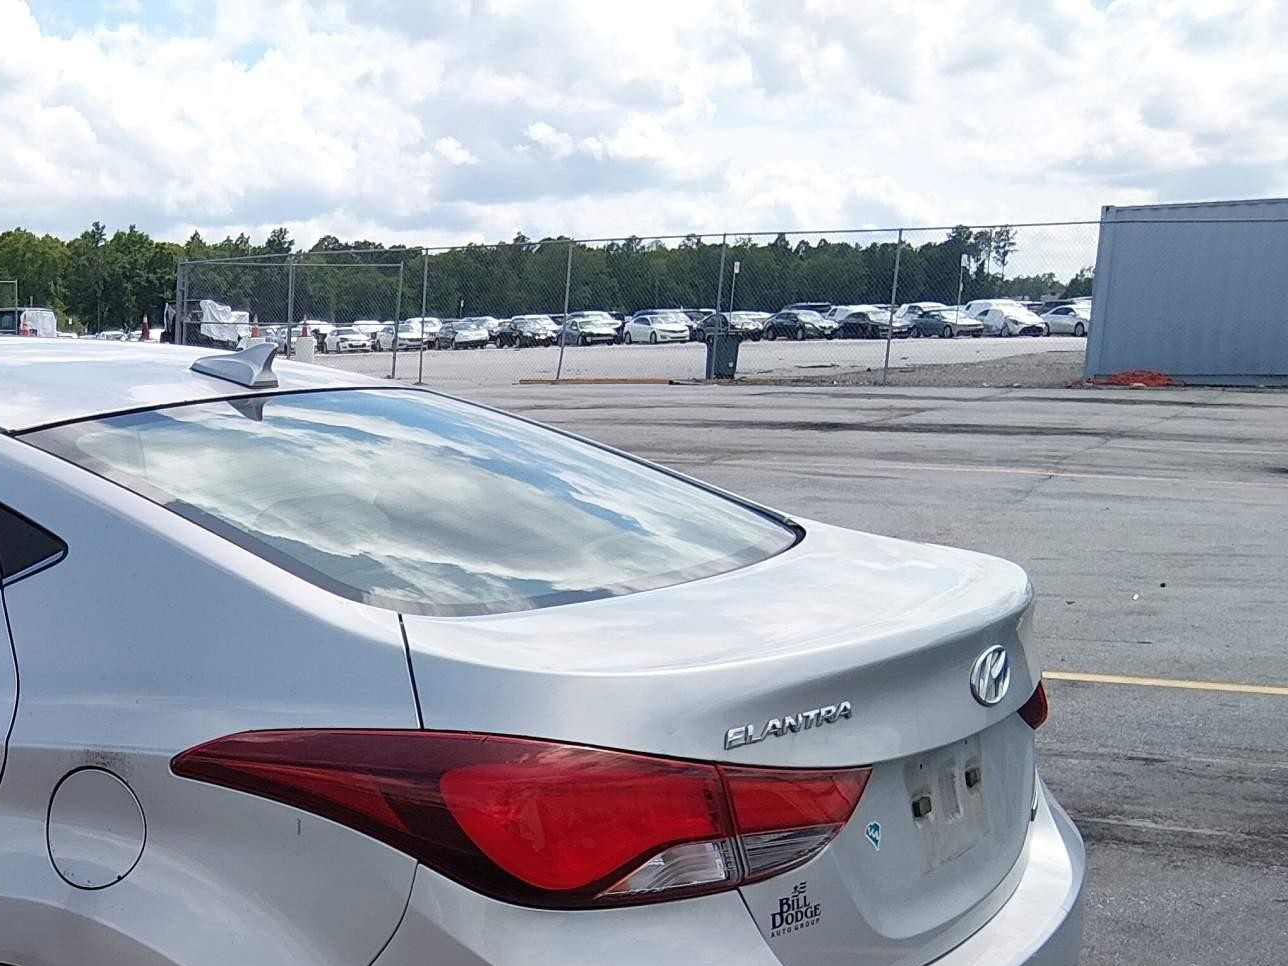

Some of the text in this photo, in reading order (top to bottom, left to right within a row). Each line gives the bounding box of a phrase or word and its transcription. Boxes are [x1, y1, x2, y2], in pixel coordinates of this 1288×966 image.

[724, 700, 852, 750] ELANTRA
[771, 917, 820, 938] AUTO GROUP
